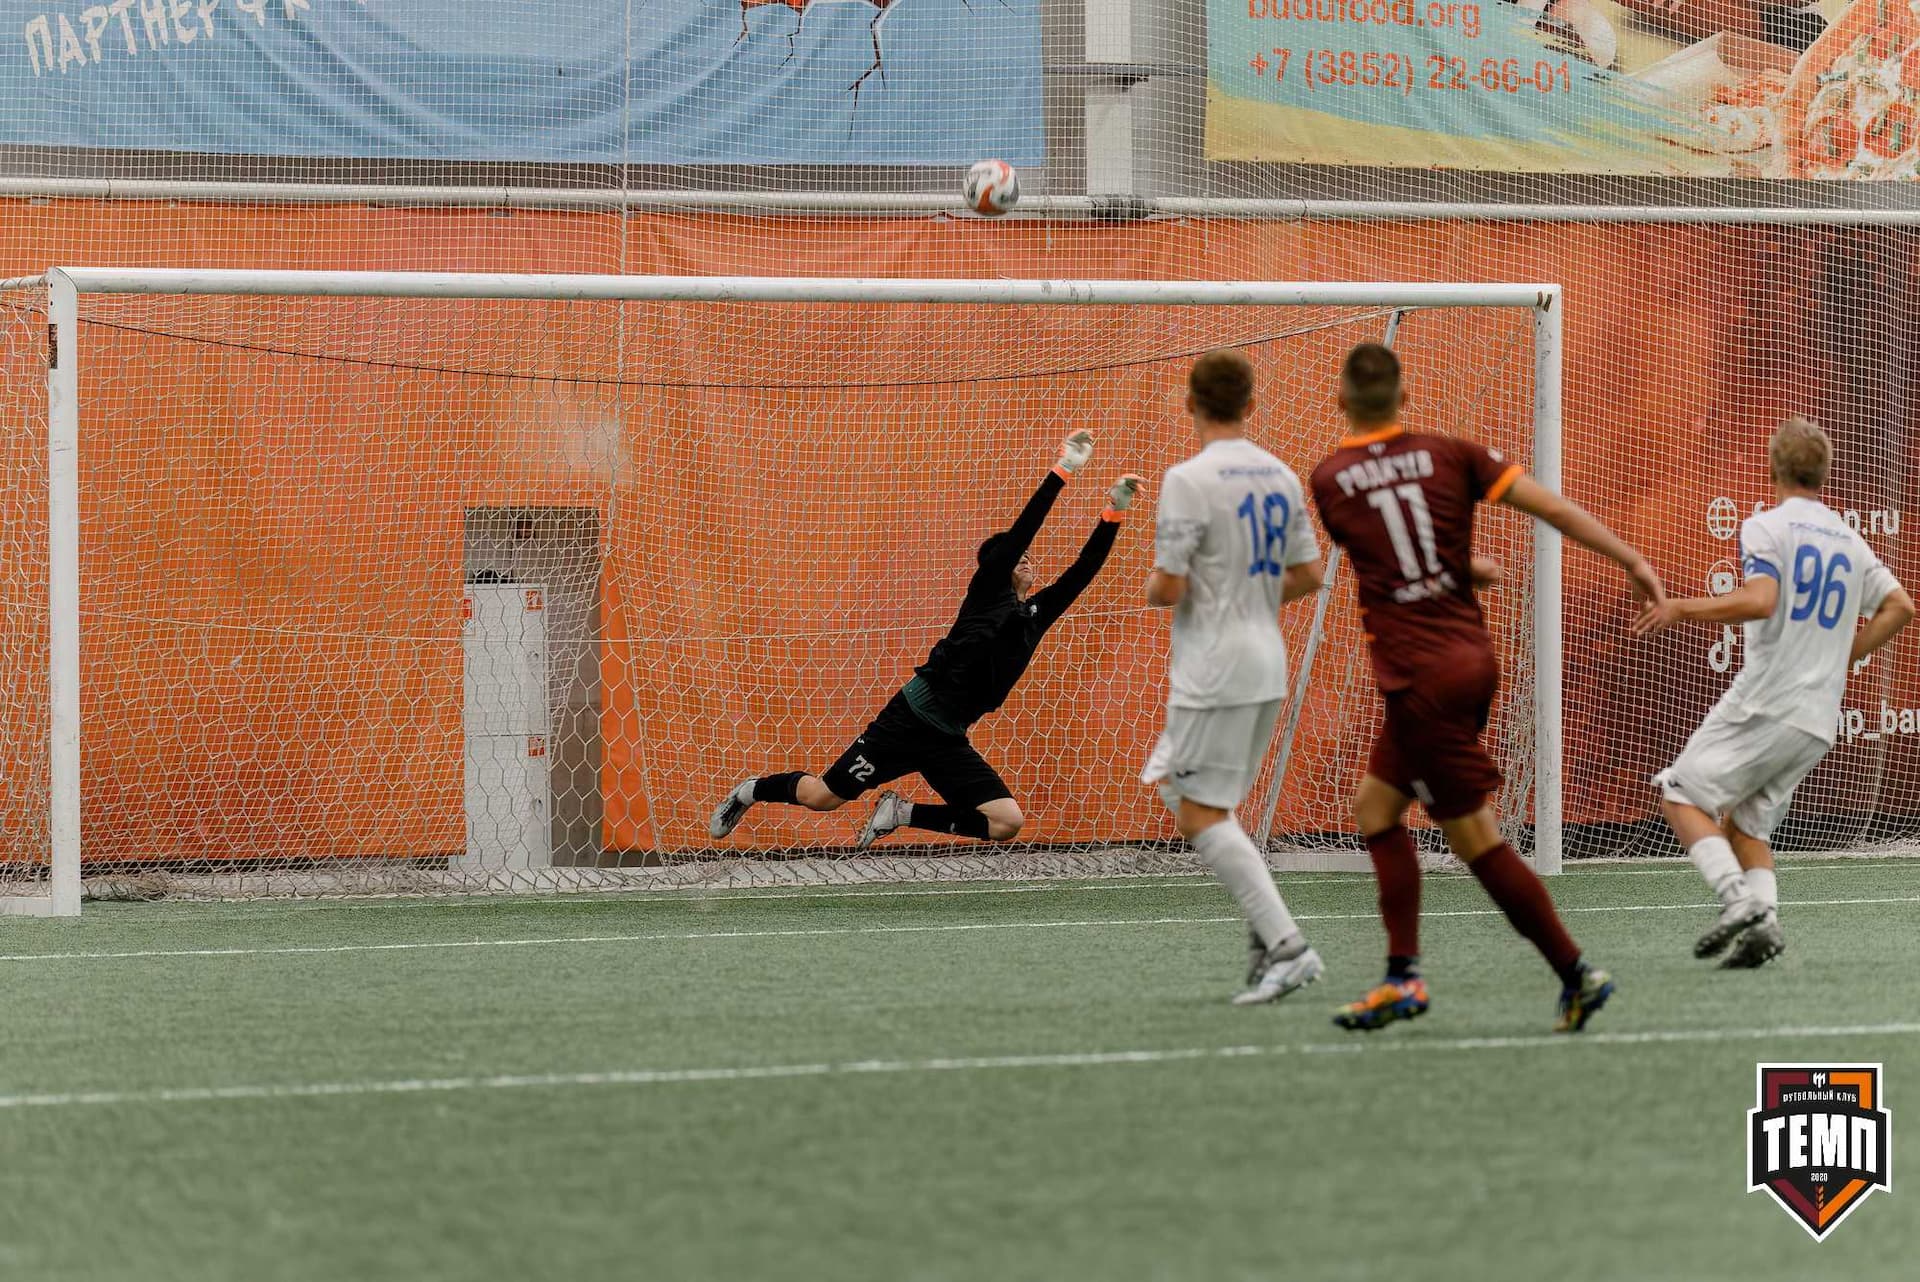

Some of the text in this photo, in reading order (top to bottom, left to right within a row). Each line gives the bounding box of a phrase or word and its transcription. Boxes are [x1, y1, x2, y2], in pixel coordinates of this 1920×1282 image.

[1248, 48, 1570, 96] +7 (3852) 22-66-01
[1238, 491, 1289, 578] 18
[1366, 482, 1442, 580] 11
[1790, 544, 1852, 630] 96
[849, 754, 876, 783] 72
